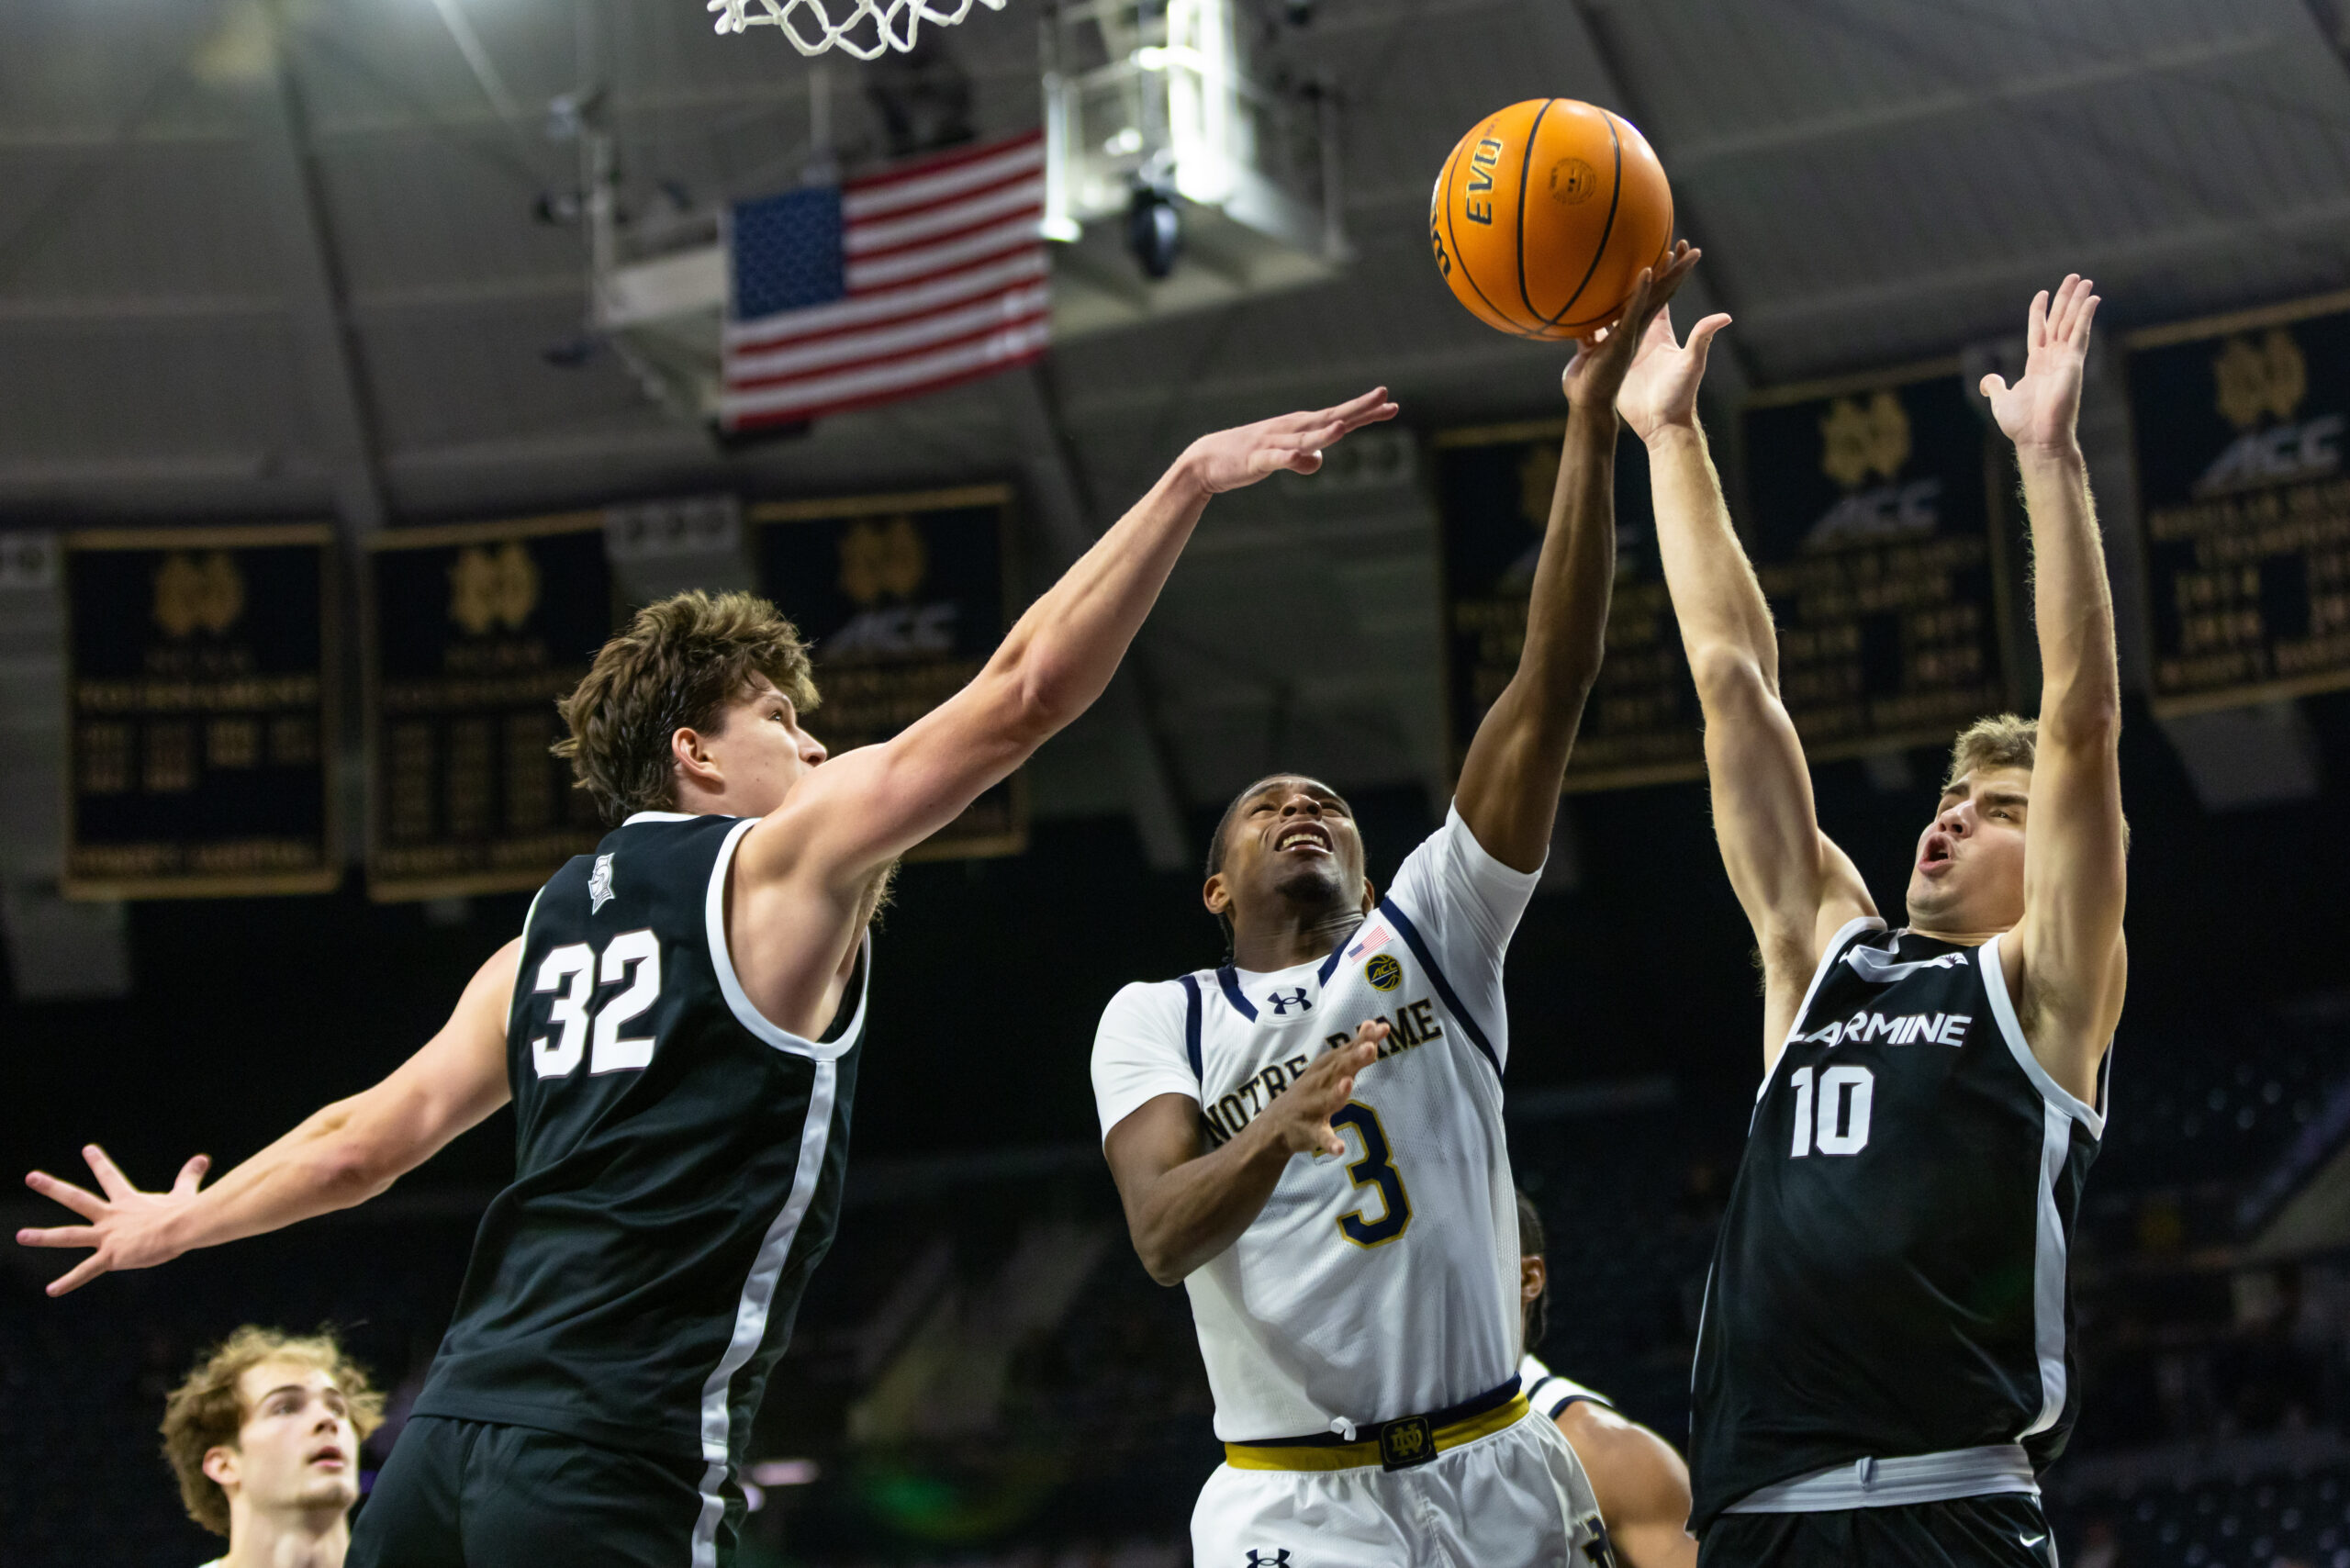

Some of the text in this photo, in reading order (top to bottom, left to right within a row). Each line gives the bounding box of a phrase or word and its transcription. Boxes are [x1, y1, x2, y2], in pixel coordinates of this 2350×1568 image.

[1466, 138, 1503, 226] EVO
[2194, 415, 2344, 494] ACC
[531, 926, 661, 1081] 32
[1371, 960, 1398, 980] ACC
[1326, 996, 1444, 1060] ME
[1790, 1065, 1875, 1159] 10
[1312, 1099, 1414, 1250] 3
